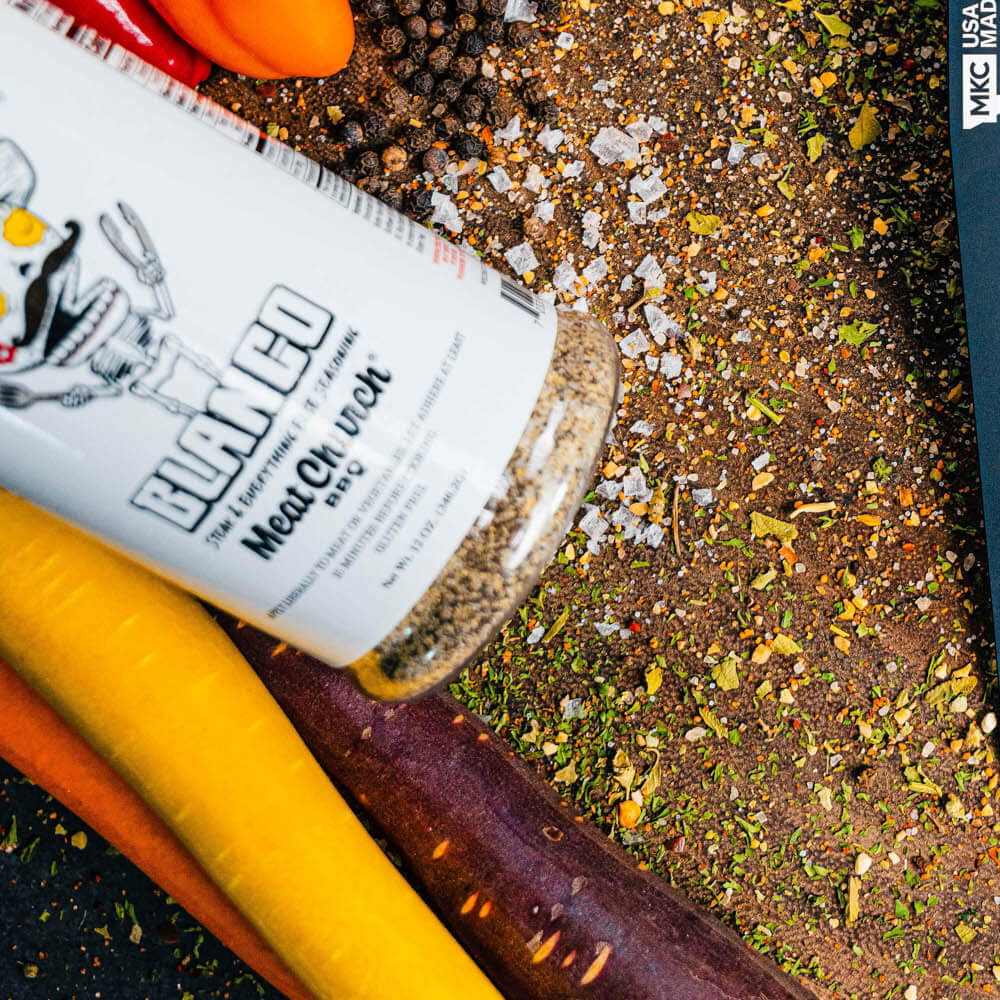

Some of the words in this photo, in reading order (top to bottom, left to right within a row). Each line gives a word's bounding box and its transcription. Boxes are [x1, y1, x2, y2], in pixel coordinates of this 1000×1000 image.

[962, 3, 979, 48] USA
[970, 62, 990, 116] MKC
[130, 284, 334, 533] BLANCO
[239, 432, 297, 507] EVERYTHING
[240, 485, 316, 560] Meat
[295, 365, 392, 489] Church
[323, 460, 365, 508] BBQ
[327, 532, 351, 560] MEAT
